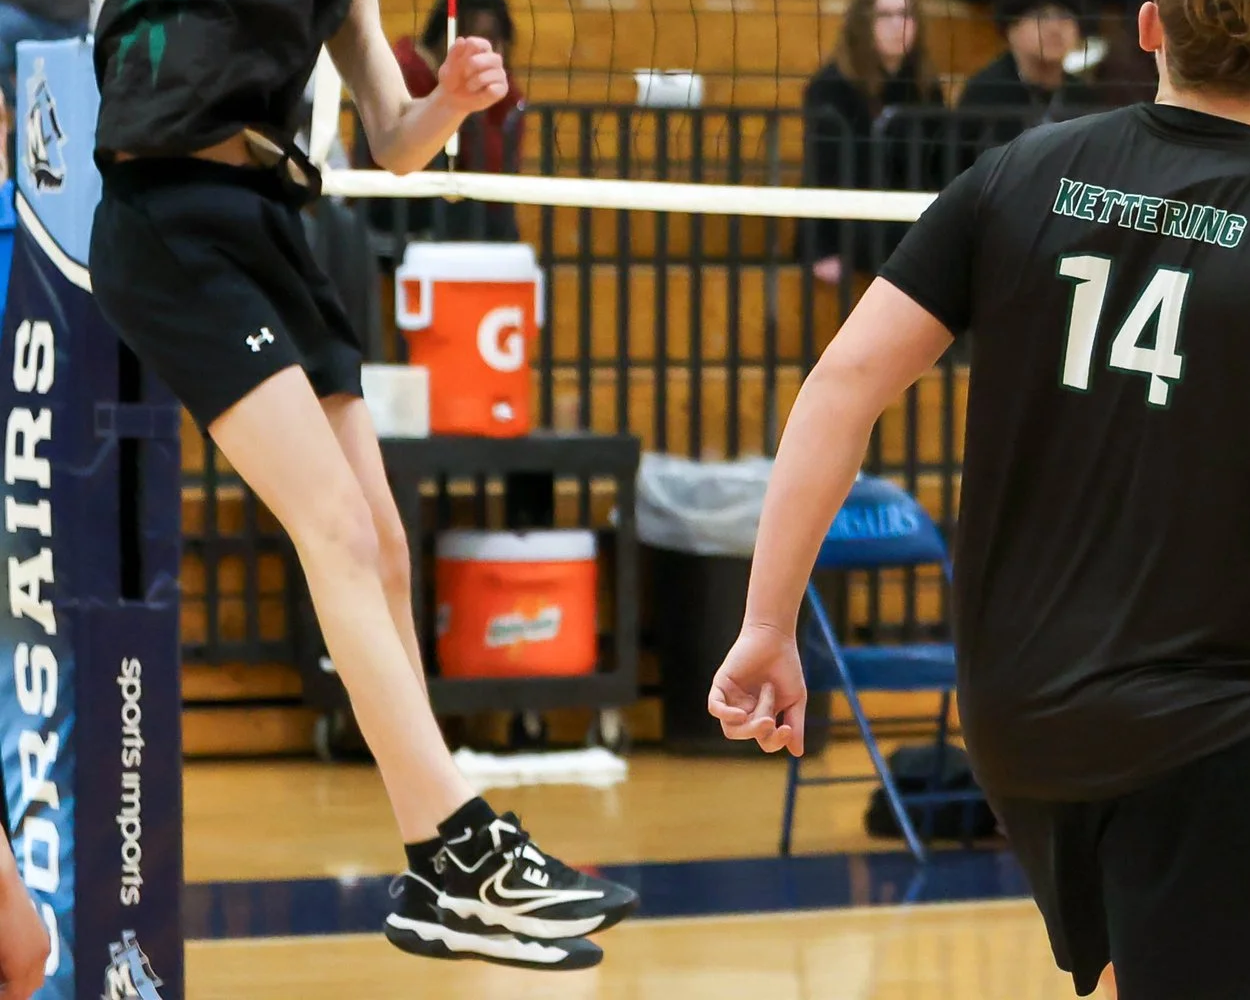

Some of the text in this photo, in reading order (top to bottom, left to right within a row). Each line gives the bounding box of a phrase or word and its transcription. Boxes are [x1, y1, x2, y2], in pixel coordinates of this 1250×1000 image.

[1053, 178, 1247, 248] KETTERING
[477, 307, 524, 372] G
[1057, 253, 1193, 408] 14
[116, 657, 145, 906] sports imports
